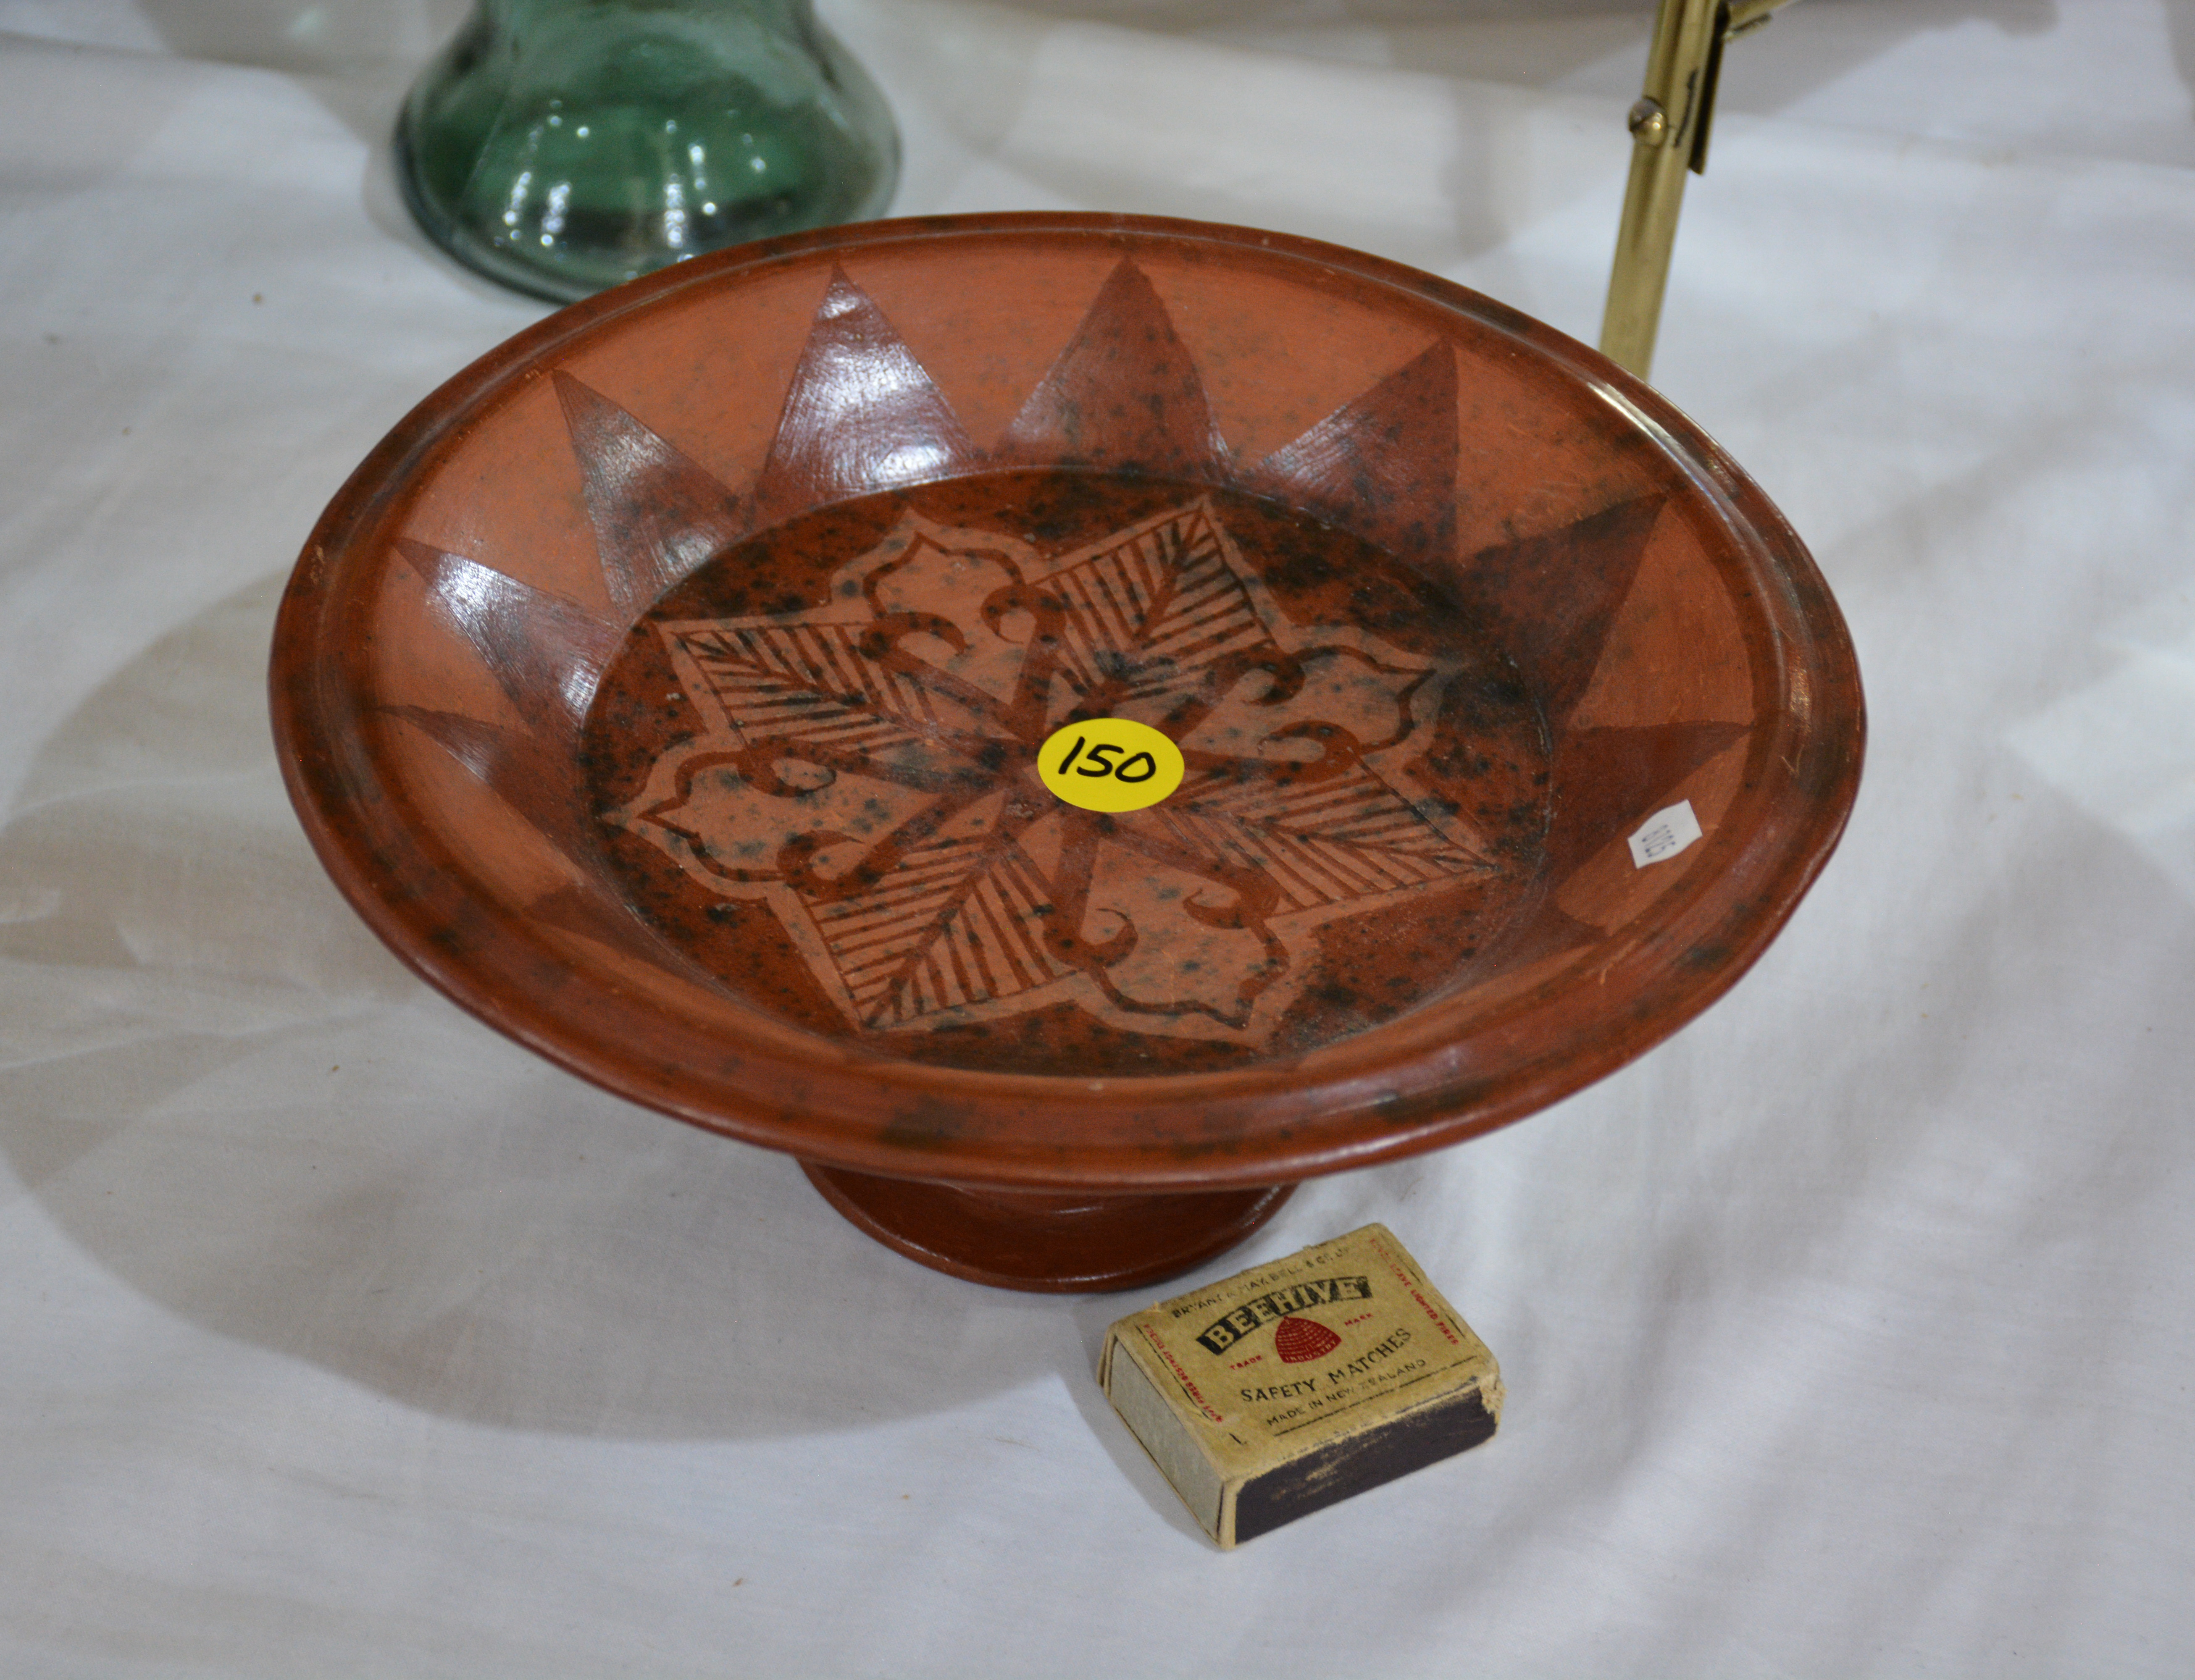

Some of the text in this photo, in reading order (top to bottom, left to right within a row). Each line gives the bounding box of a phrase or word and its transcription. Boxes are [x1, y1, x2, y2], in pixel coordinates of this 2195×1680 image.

[1058, 736, 1157, 783] 150
[1202, 1277, 1364, 1352] BEEHIVE
[1229, 1312, 1374, 1370] TRADE MARK
[1241, 1328, 1411, 1402] SAFETY MATCHES
[1267, 1358, 1427, 1426] MADE IN NEW ZEALAND
